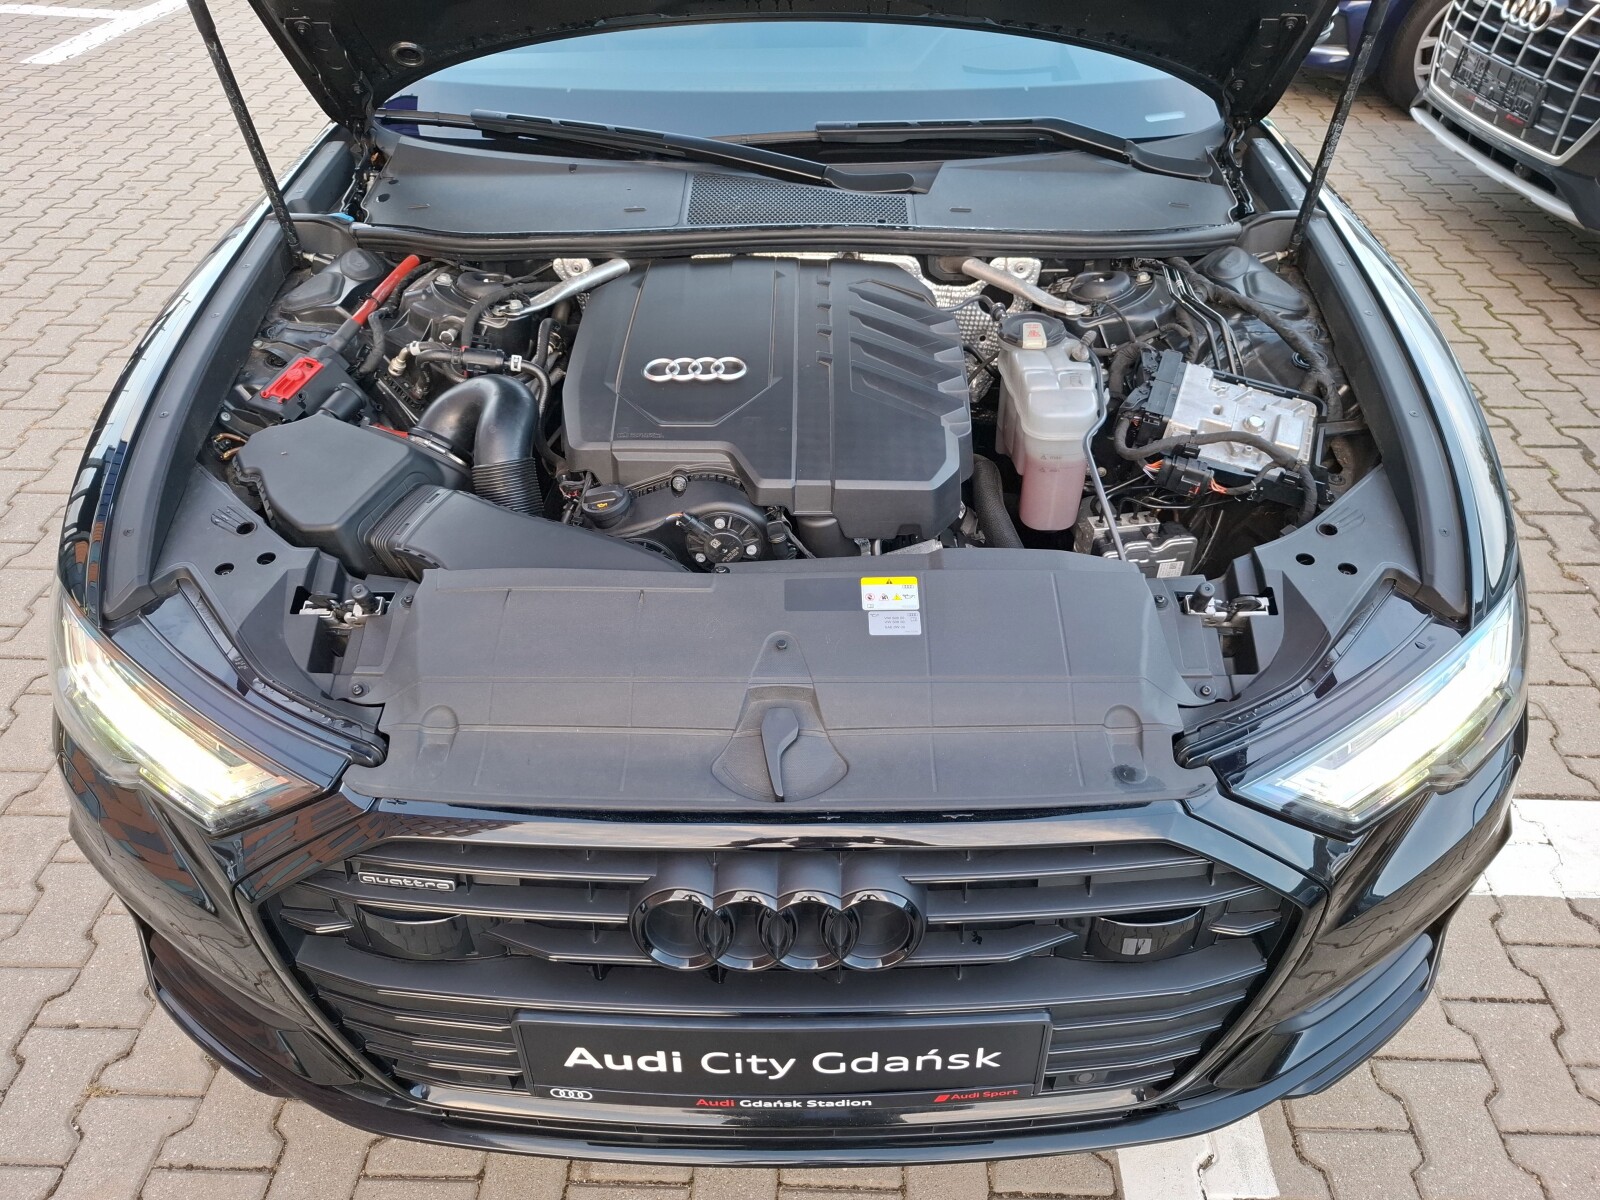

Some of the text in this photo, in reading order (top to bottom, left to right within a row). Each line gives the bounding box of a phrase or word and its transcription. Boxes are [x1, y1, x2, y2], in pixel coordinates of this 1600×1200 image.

[362, 875, 450, 889] quattro
[563, 1047, 1003, 1080] Audi City Gdańsk
[950, 1089, 1020, 1101] Audi Sport
[696, 1098, 873, 1108] Audi Gdańsk Stadion
